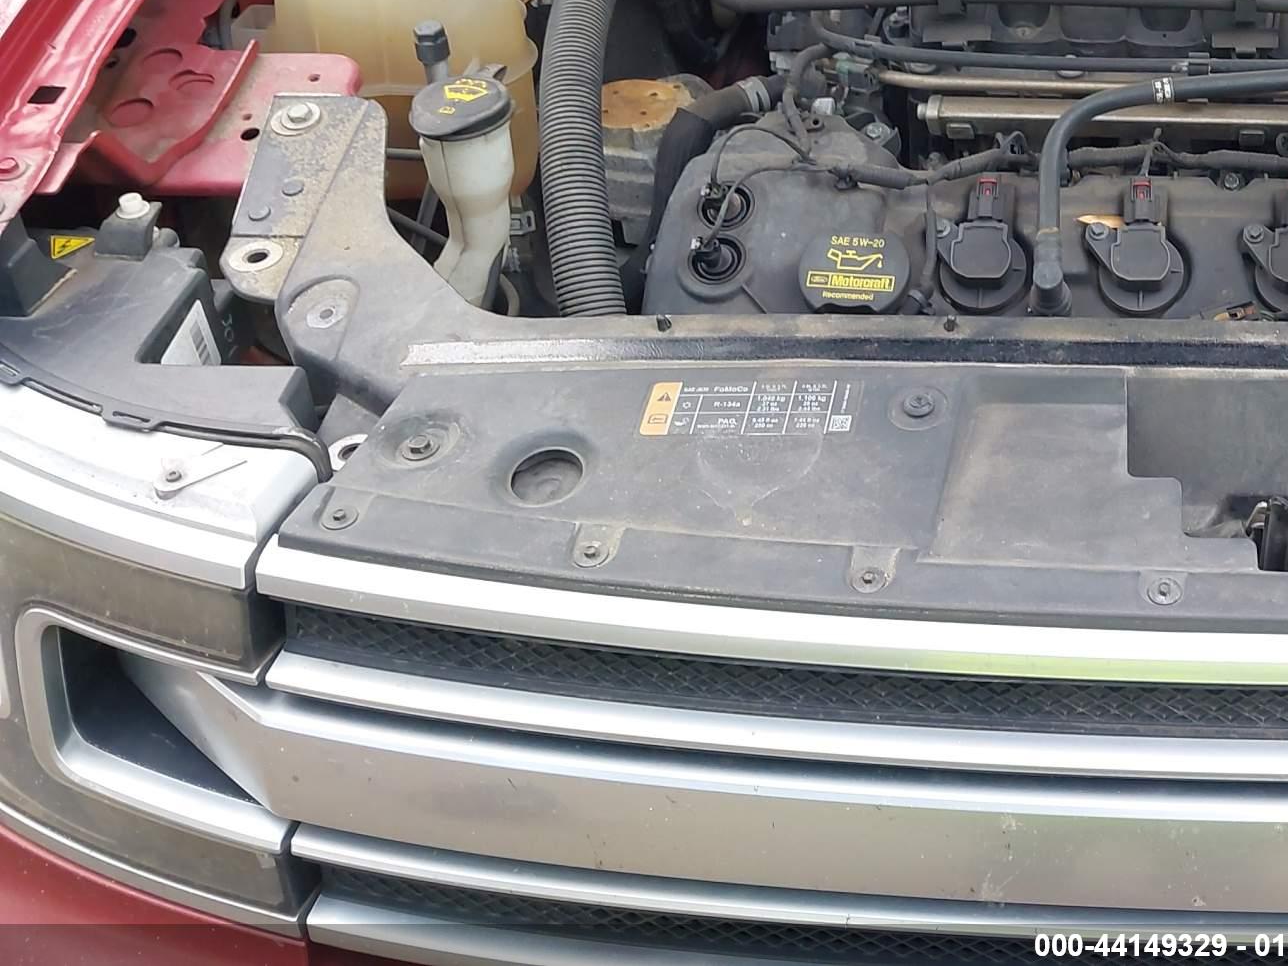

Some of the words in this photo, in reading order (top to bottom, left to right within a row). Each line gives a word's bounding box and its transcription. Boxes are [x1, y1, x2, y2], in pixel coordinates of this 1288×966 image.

[831, 235, 850, 246] SAE
[852, 237, 885, 248] 5W-20
[831, 275, 890, 289] Motorcraft
[822, 291, 874, 300] Recommended
